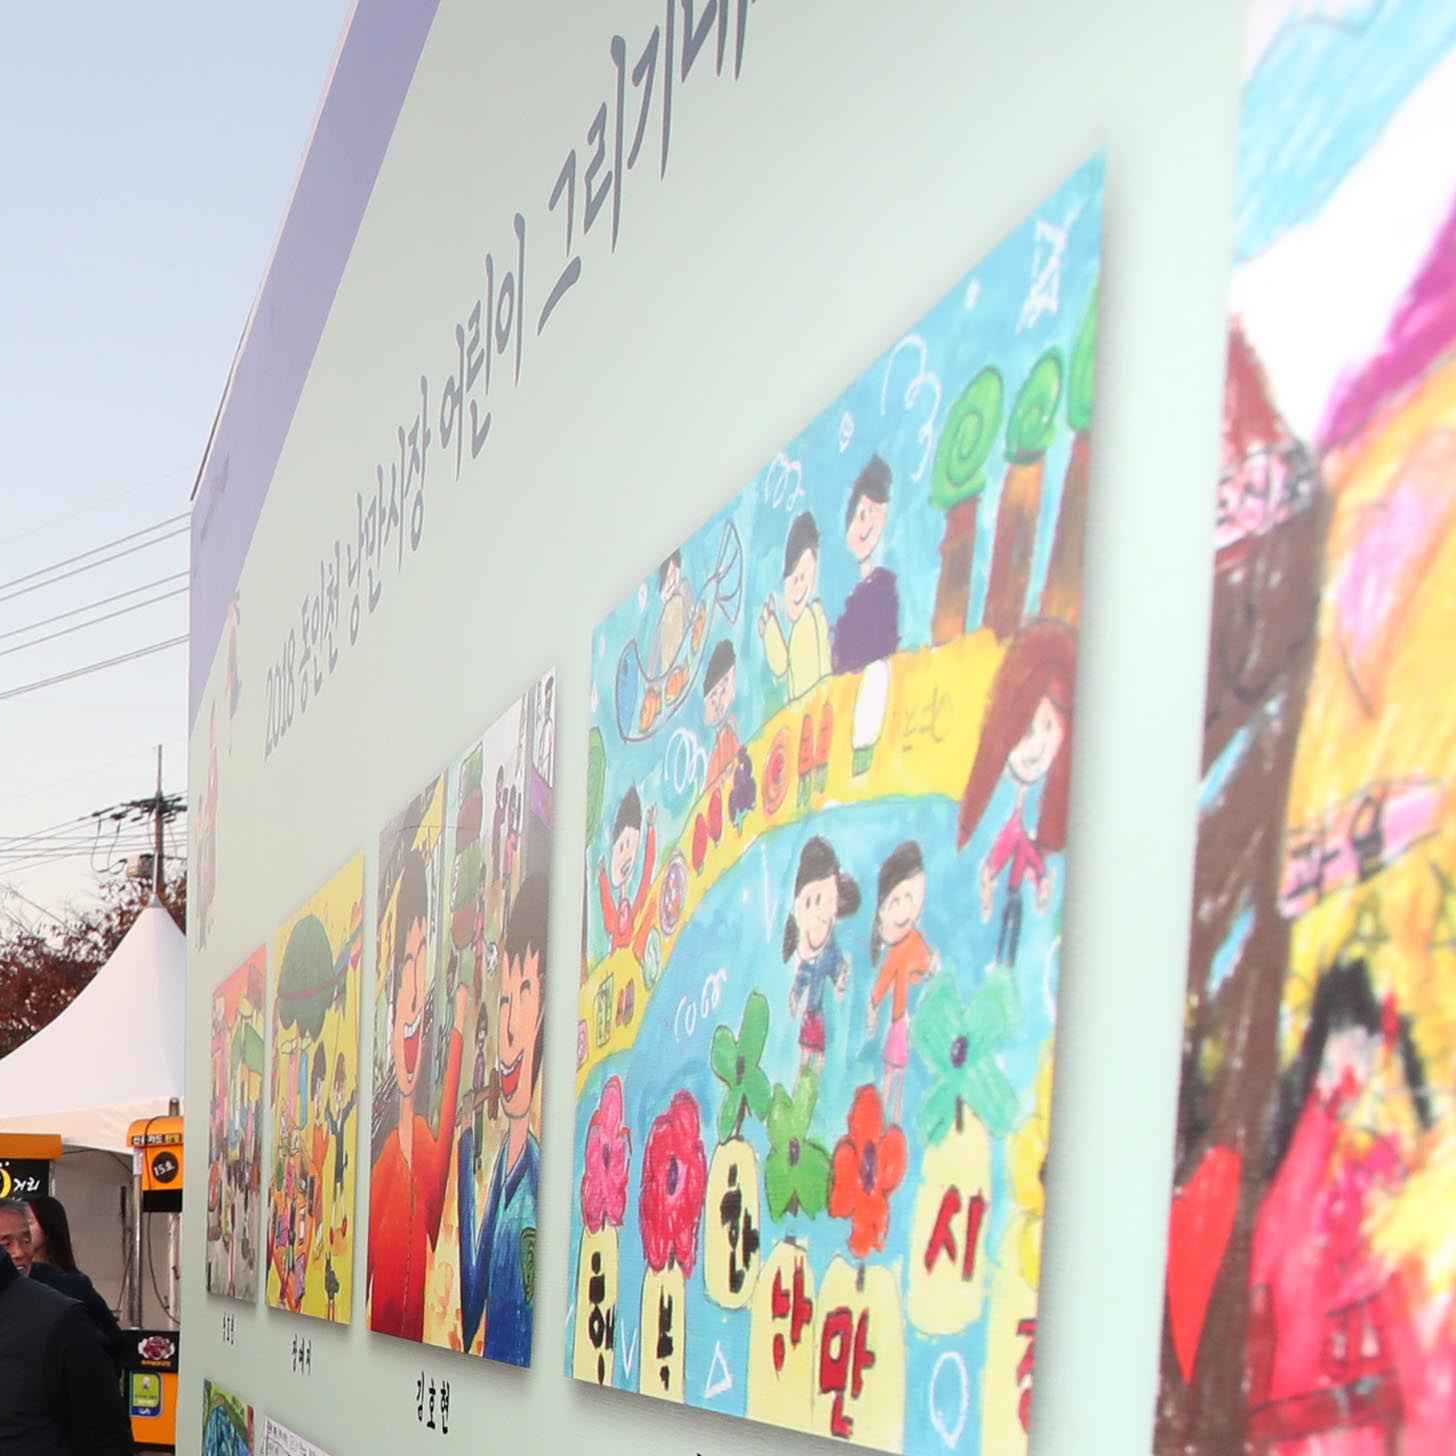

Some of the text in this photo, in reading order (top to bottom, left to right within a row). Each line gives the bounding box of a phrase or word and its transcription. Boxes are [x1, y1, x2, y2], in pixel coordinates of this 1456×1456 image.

[263, 628, 295, 761] 2018
[299, 540, 341, 714] 동인천
[346, 375, 431, 647] 낭만시장
[439, 212, 525, 482] 어린이
[416, 1370, 450, 1435] 김호현
